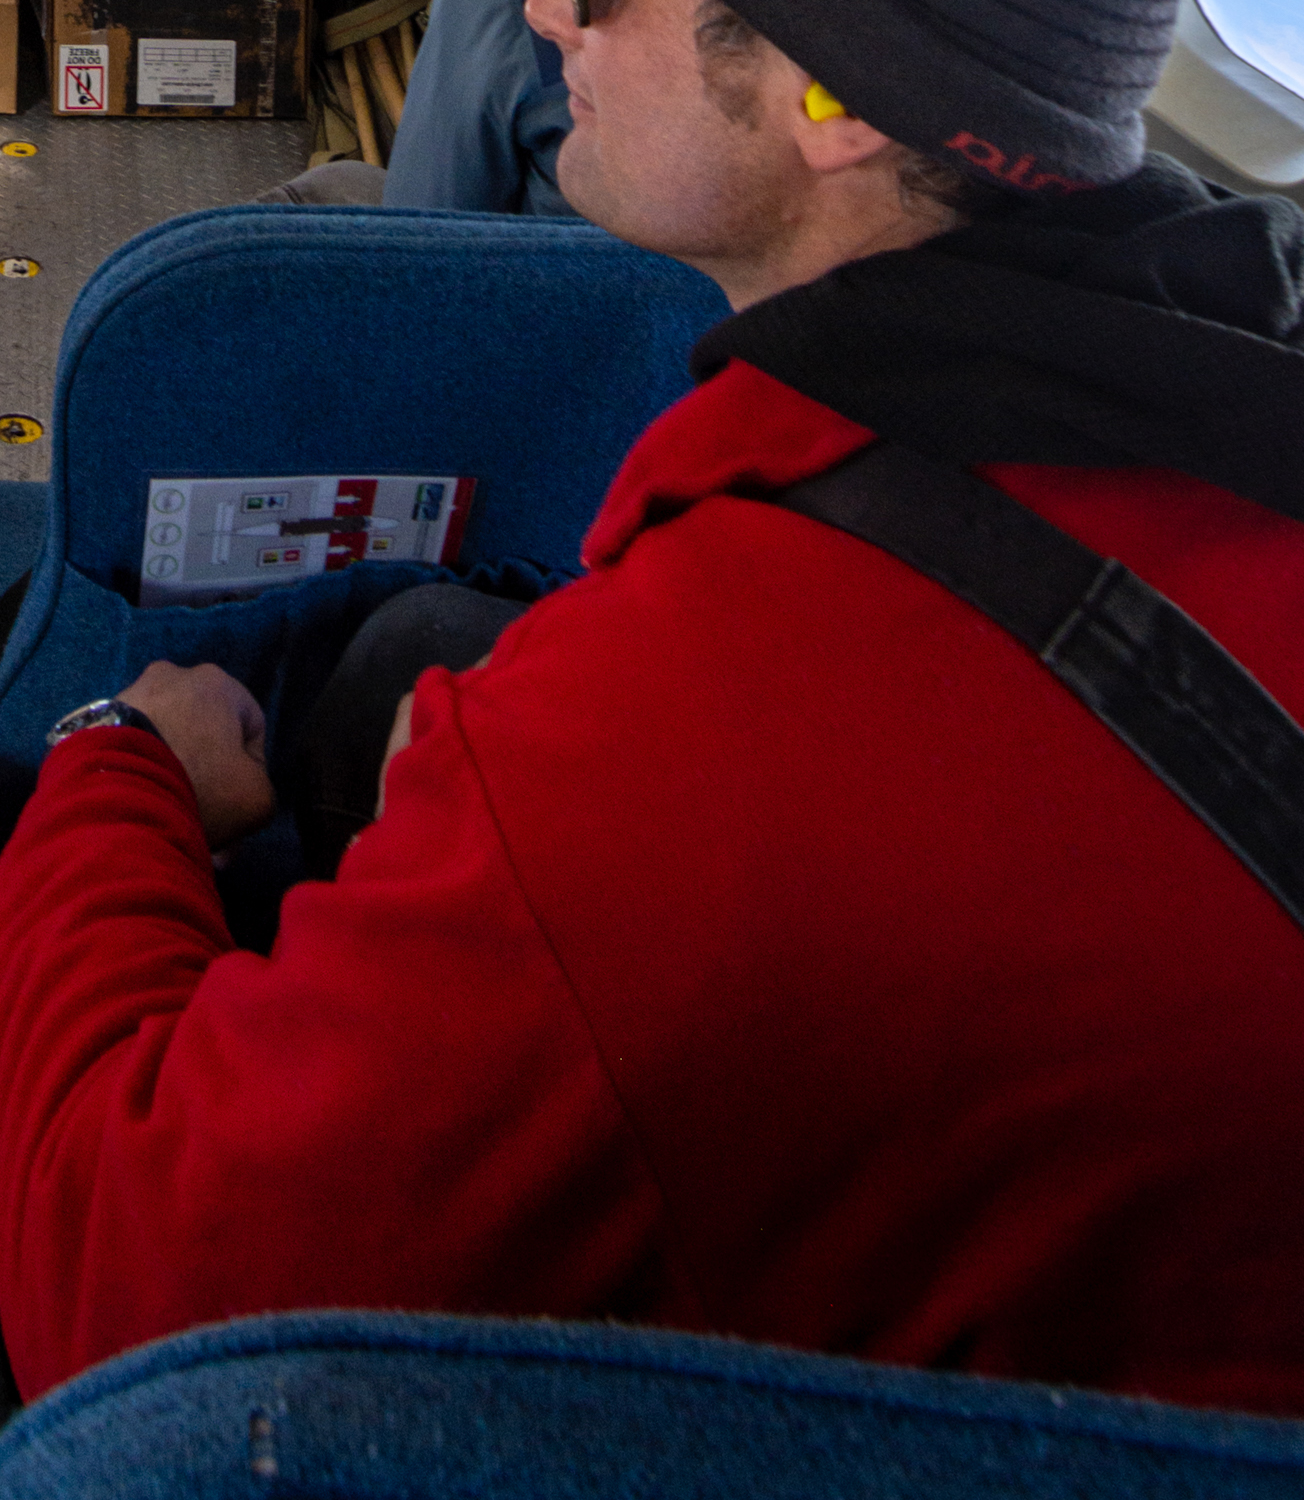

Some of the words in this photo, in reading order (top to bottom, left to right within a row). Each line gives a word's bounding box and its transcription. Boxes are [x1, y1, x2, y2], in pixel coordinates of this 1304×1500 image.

[69, 48, 100, 57] FREEZE
[67, 56, 85, 65] NOT
[87, 57, 101, 66] DO
